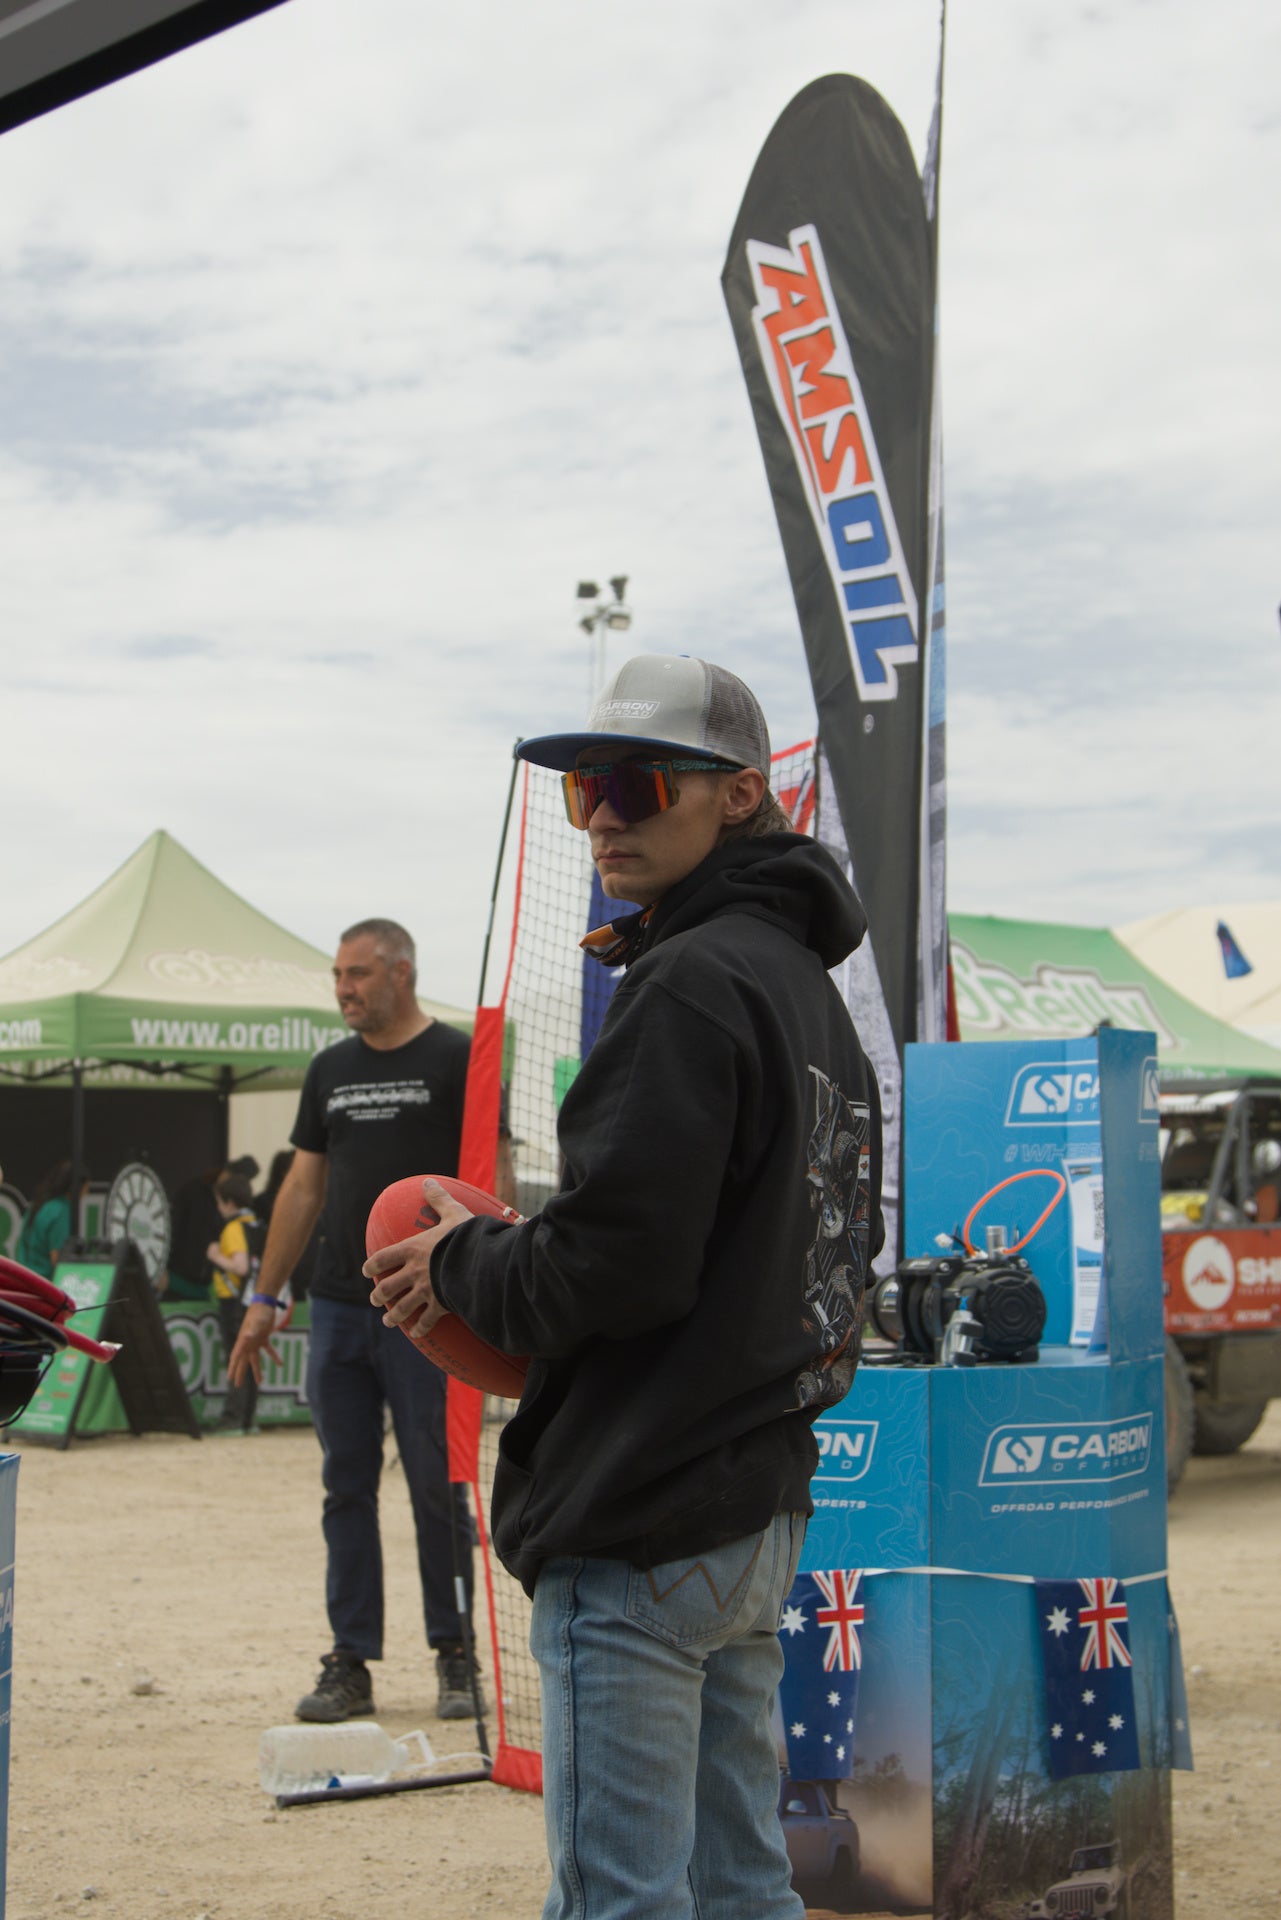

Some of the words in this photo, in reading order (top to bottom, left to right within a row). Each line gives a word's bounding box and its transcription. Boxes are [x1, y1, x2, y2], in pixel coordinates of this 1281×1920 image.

[747, 224, 918, 701] AMSOIL
[1051, 1424, 1149, 1460] CARBON
[991, 1502, 1055, 1513] OFFROAD
